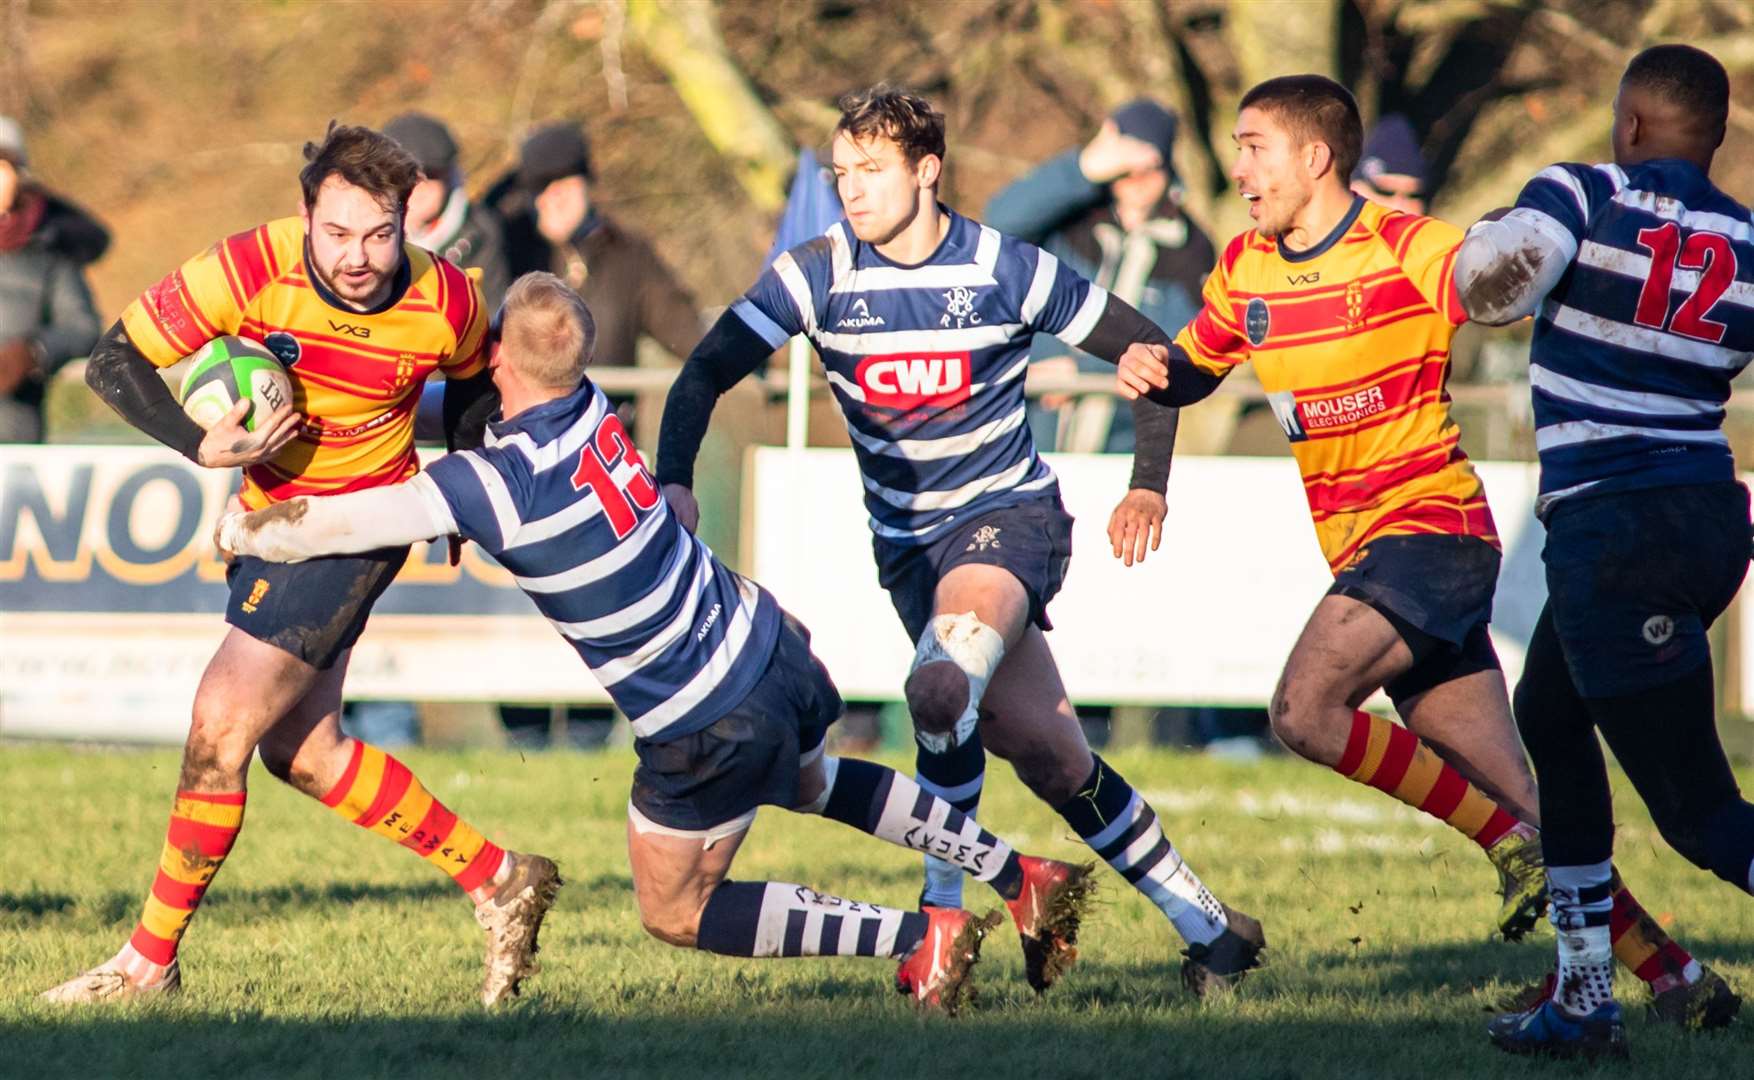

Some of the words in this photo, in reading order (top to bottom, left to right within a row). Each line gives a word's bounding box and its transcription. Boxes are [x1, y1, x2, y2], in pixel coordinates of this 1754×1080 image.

[1286, 271, 1320, 286] VX3
[1633, 221, 1738, 344] 12
[328, 319, 370, 338] VX3
[837, 315, 885, 327] AKUMA
[864, 358, 963, 396] CWJ
[1302, 385, 1383, 418] MOUSER
[1307, 400, 1386, 428] ELECTRONICS
[570, 413, 661, 541] 13
[697, 602, 723, 643] AKUMA
[383, 811, 468, 866] MEDWAY
[904, 826, 991, 869] AKUMA
